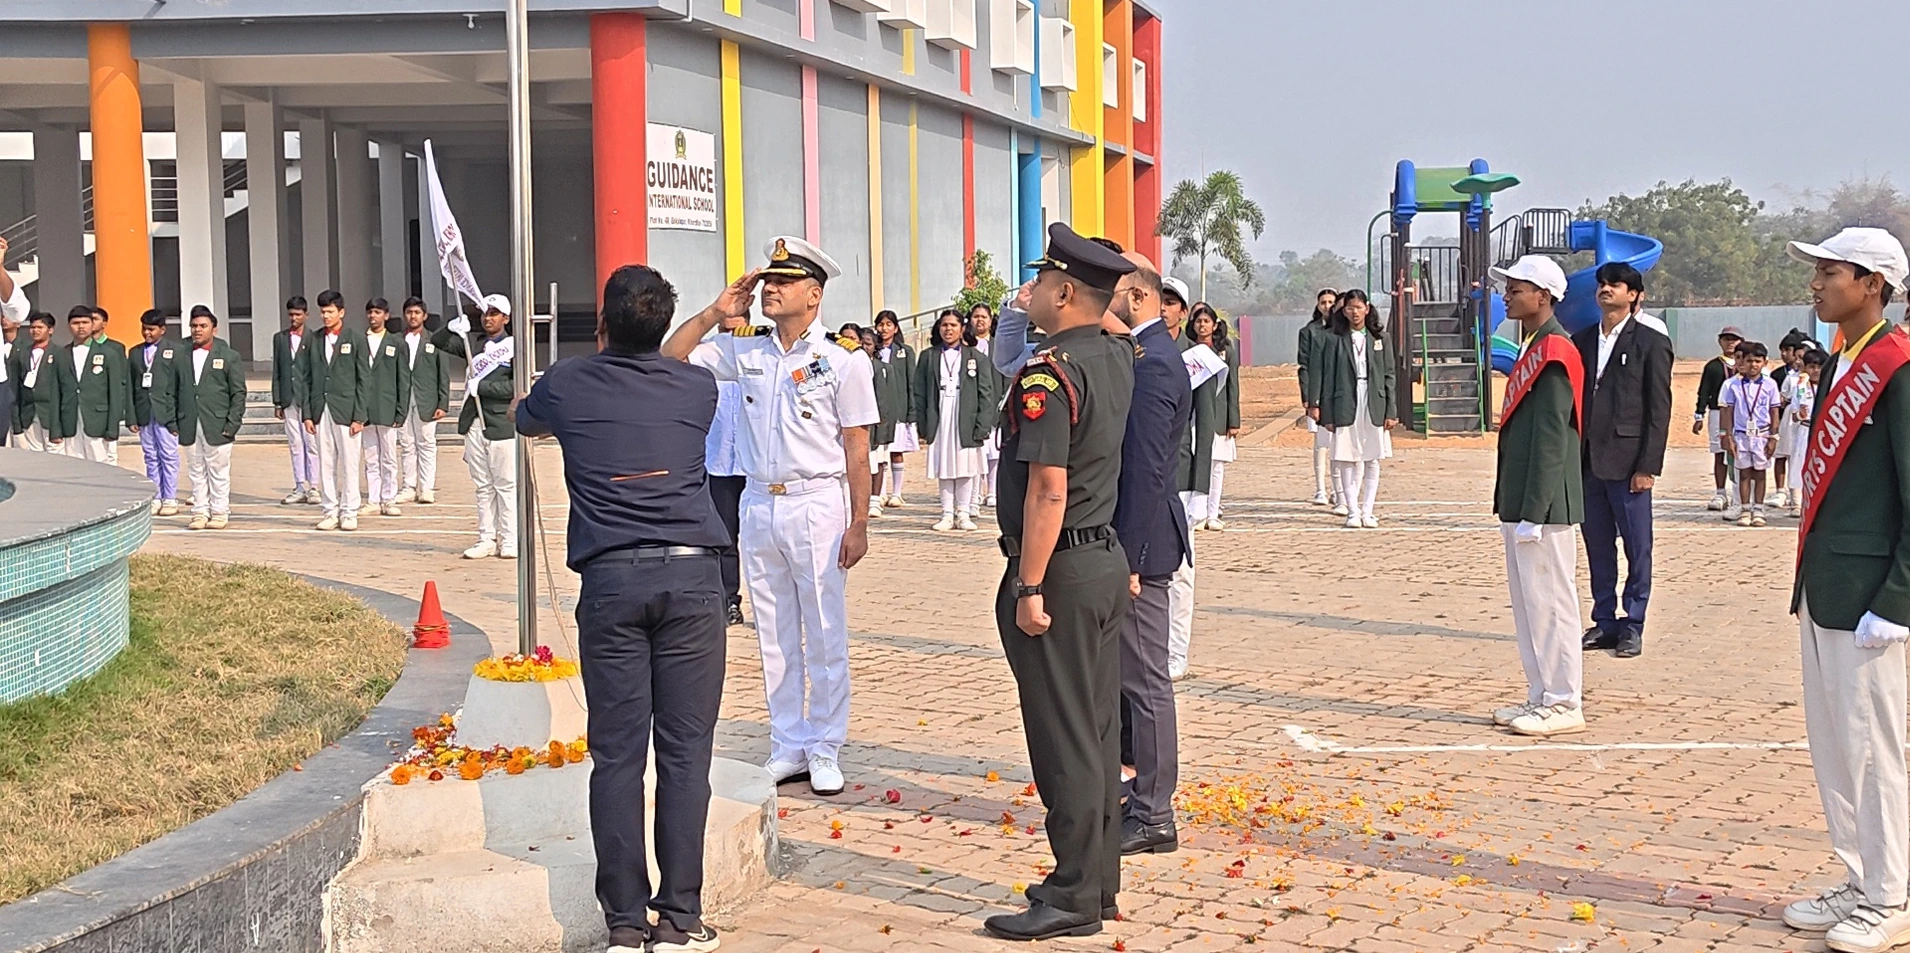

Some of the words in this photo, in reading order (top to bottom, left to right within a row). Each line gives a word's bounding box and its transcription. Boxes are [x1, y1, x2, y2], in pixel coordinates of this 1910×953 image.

[647, 160, 714, 193] GUIDANCE
[649, 194, 692, 210] NTERNATIONAL
[693, 197, 714, 213] SCHOOL
[1503, 344, 1543, 414] APTAIN
[1817, 362, 1881, 457] CAPTAIN
